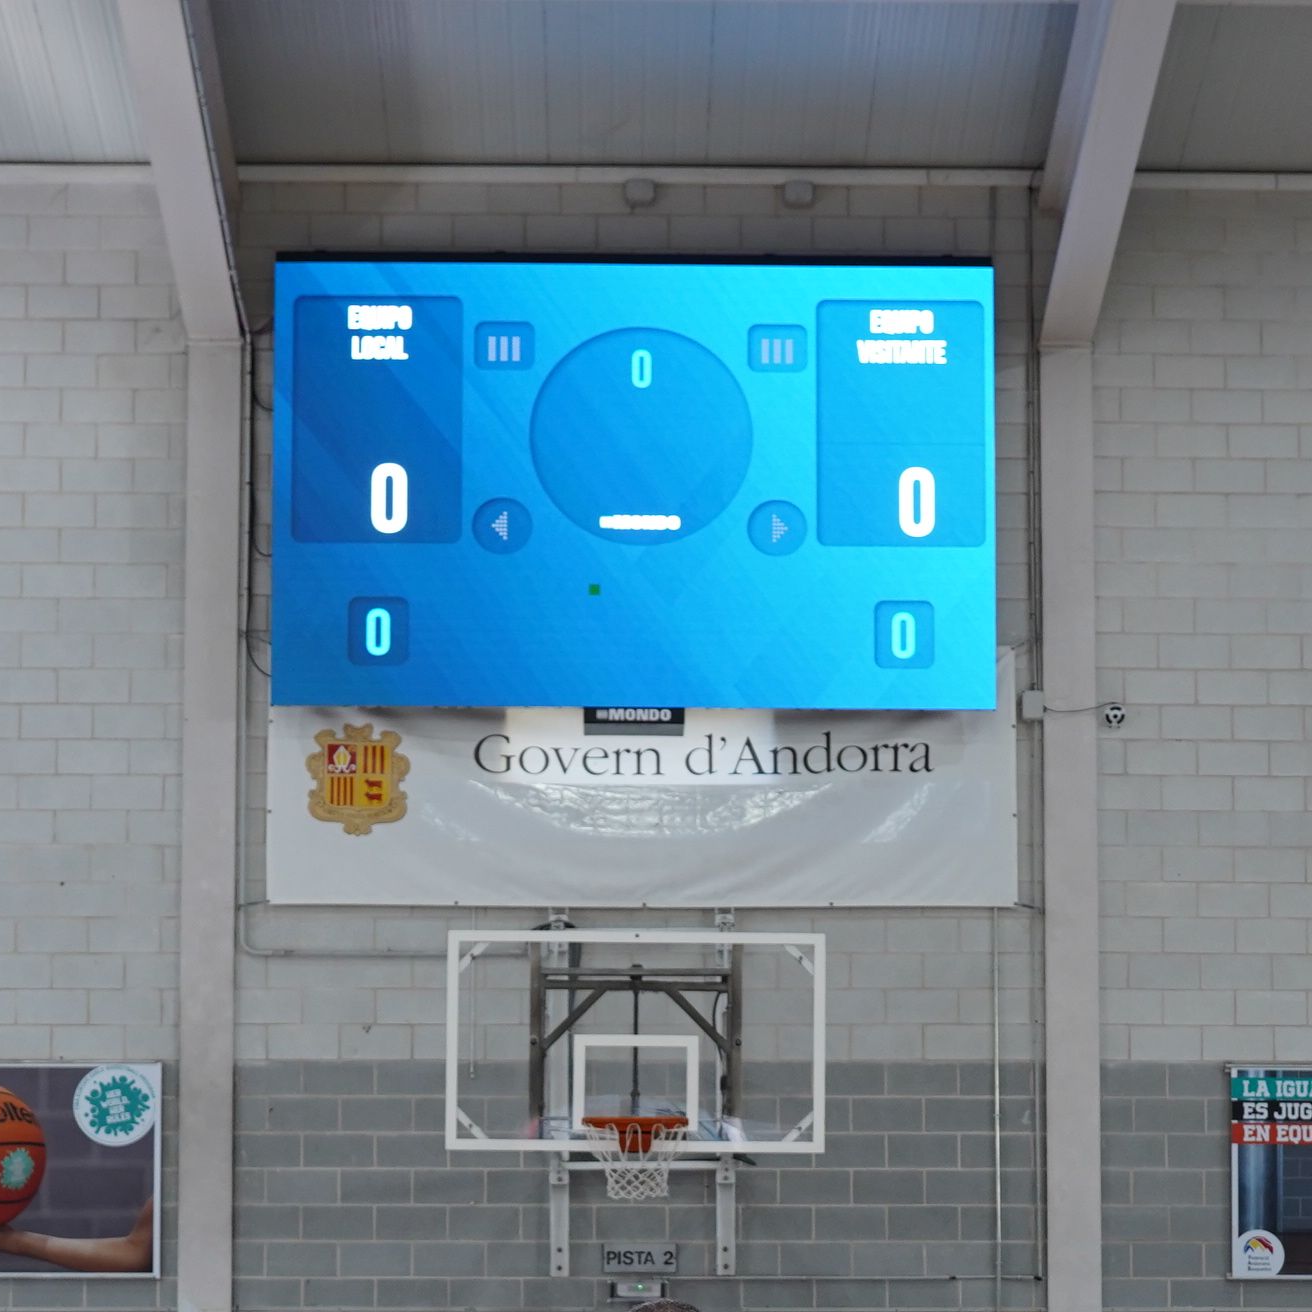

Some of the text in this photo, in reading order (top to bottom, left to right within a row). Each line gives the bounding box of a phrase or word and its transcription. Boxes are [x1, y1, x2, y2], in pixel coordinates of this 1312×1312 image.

[350, 335, 409, 360] LOCAL
[631, 350, 652, 389] 0
[370, 462, 408, 534] 0
[898, 466, 936, 538] 0
[366, 608, 391, 656] 0
[891, 612, 916, 659] 0
[608, 708, 672, 722] MONDO
[473, 733, 663, 776] Govern
[1242, 1079, 1271, 1098] LA
[1242, 1102, 1269, 1120] ES
[1242, 1124, 1271, 1142] EN
[605, 1250, 674, 1266] PISTA 2
